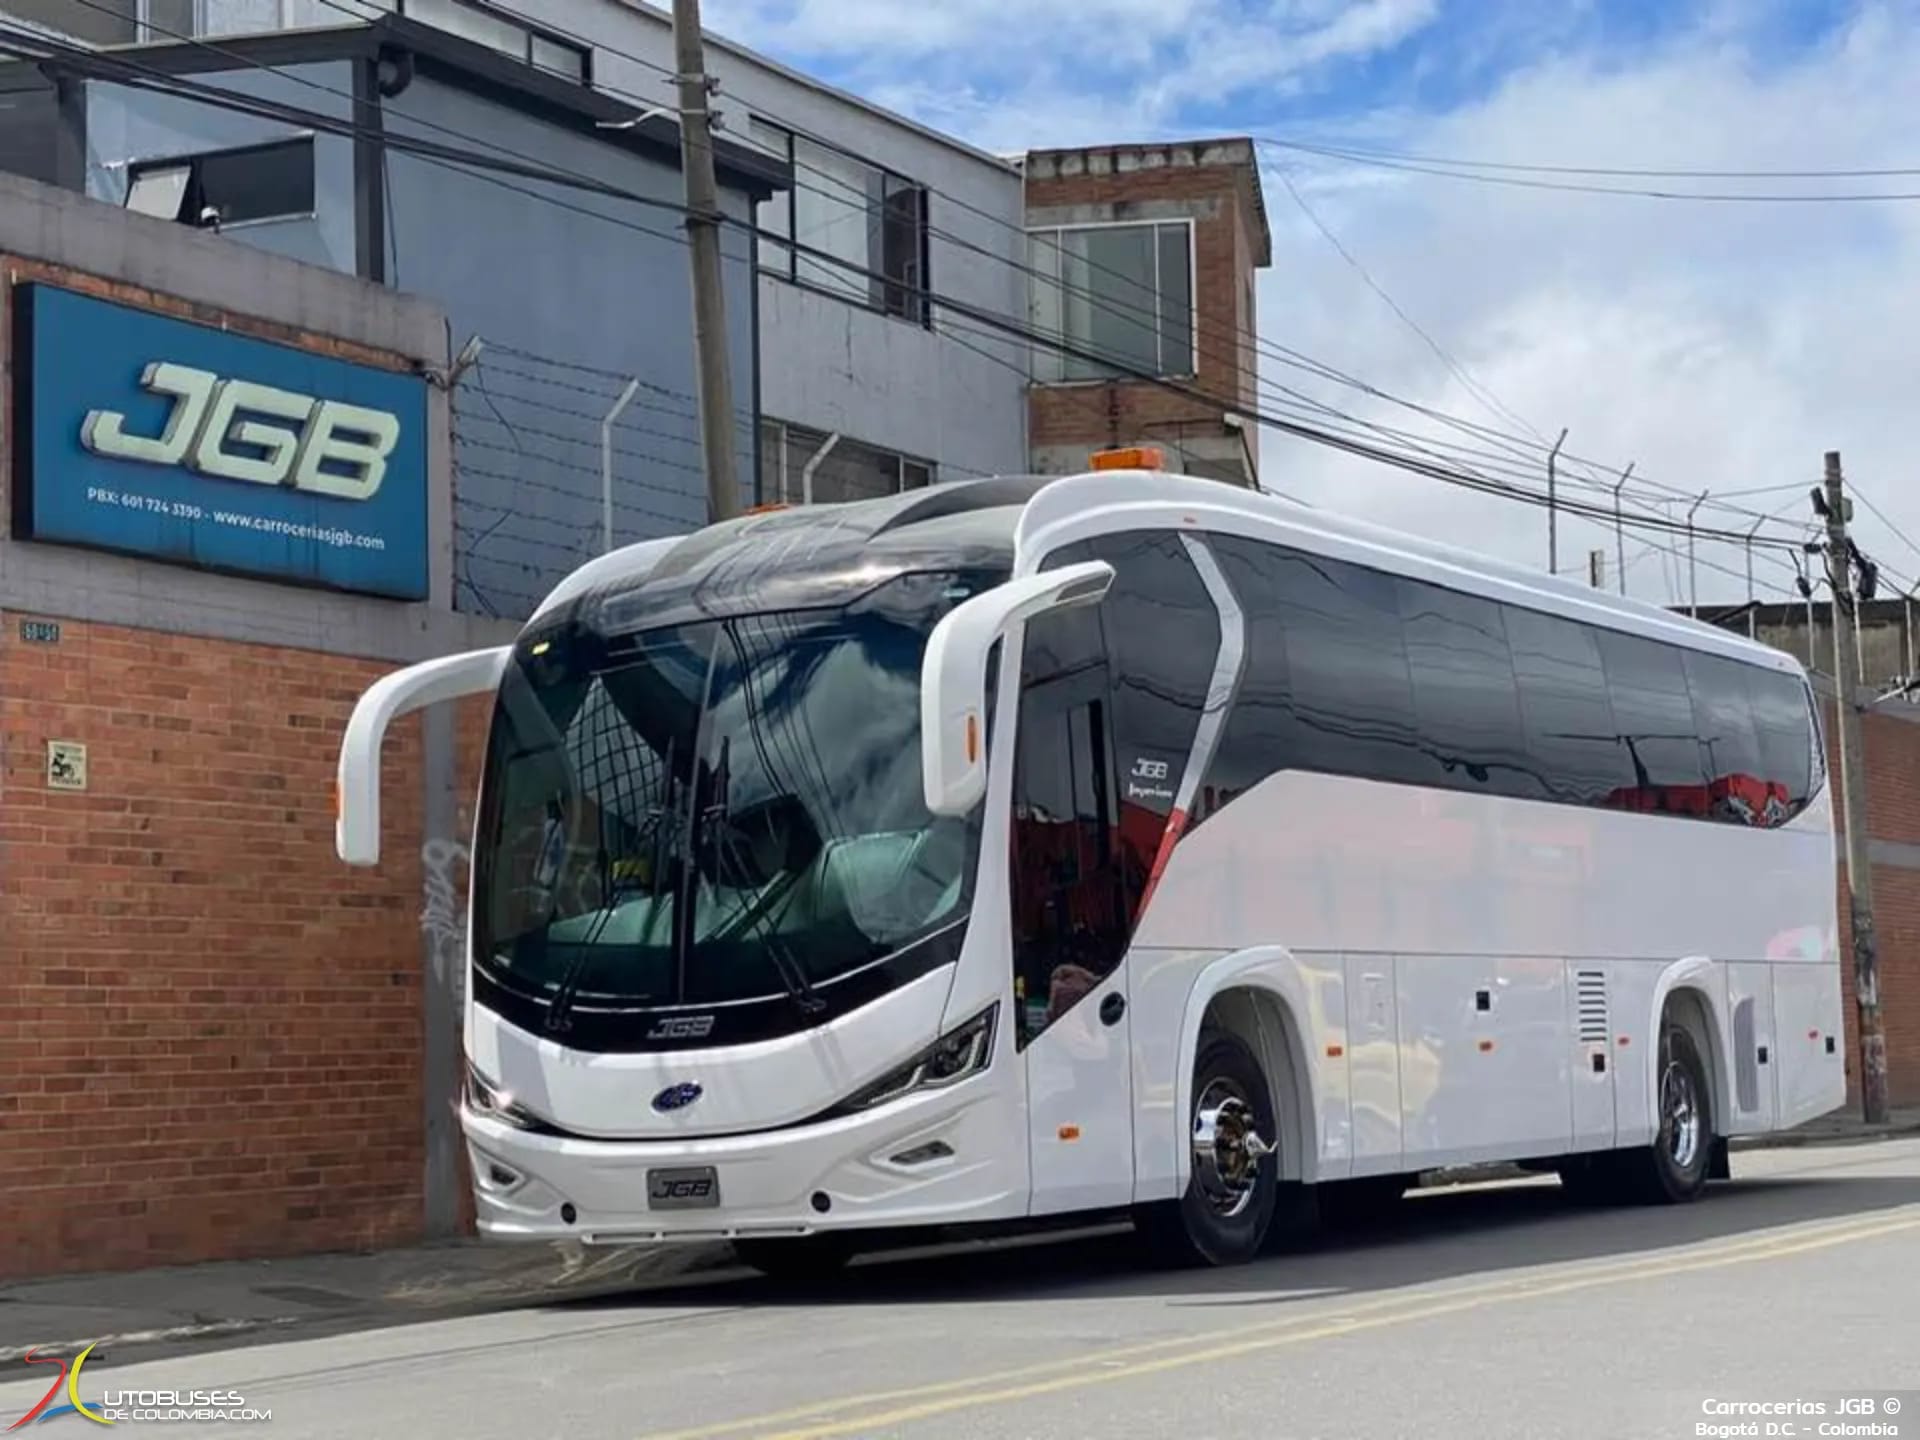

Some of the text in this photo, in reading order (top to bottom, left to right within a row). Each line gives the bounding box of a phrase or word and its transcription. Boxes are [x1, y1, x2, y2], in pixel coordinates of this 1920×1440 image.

[80, 361, 400, 500] JGB
[87, 487, 119, 504] PBX:
[121, 493, 143, 510] 601
[146, 498, 169, 513] 724
[213, 511, 385, 550] www.carroceriasjgb.com
[1131, 757, 1169, 779] JGB
[646, 1015, 715, 1039] JGB
[652, 1179, 712, 1199] JGB
